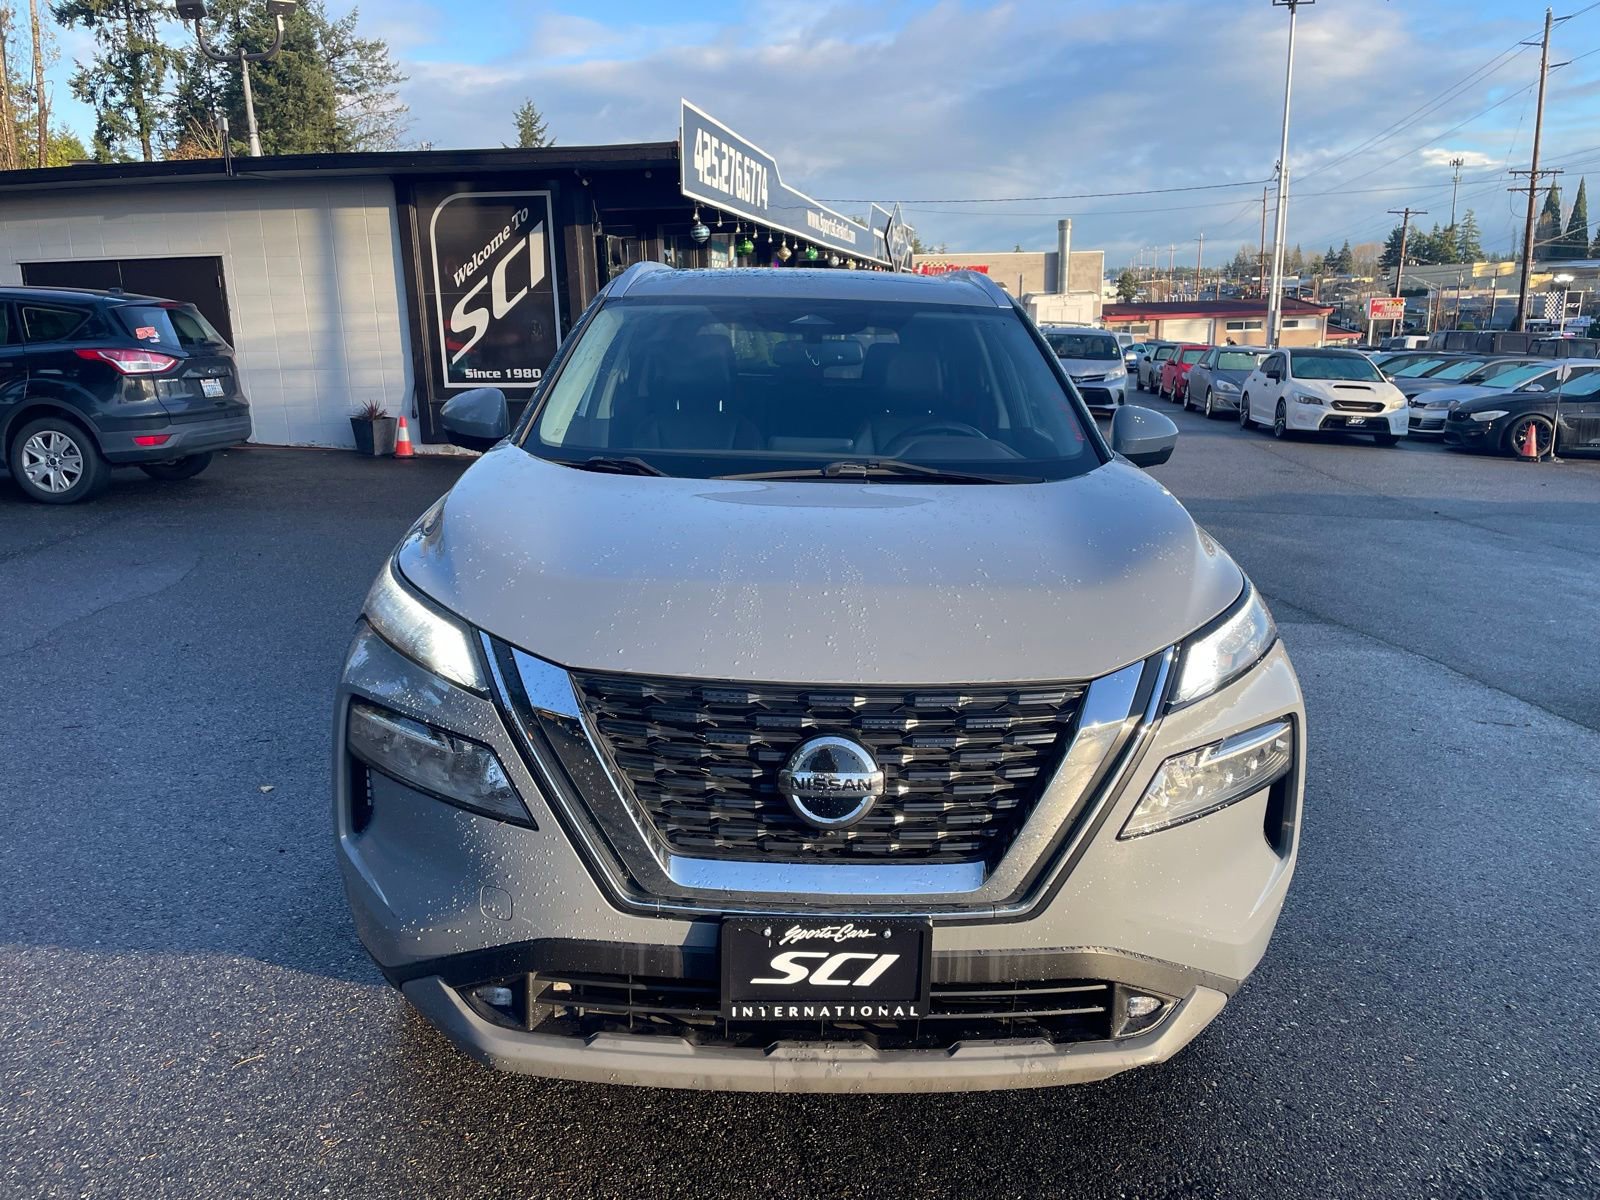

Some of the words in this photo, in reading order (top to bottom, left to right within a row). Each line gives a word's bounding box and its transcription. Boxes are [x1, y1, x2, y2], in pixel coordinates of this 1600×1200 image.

[694, 127, 768, 211] 425.276.6774
[453, 224, 511, 289] Welcome
[511, 206, 529, 231] To
[450, 219, 545, 365] SCI
[465, 368, 502, 379] Since
[505, 368, 542, 379] 1980
[790, 776, 872, 791] NISSAN
[779, 924, 835, 946] Sports
[834, 923, 877, 943] Cars
[750, 951, 900, 987] SCI
[732, 1006, 919, 1018] INTERNATIONAL
